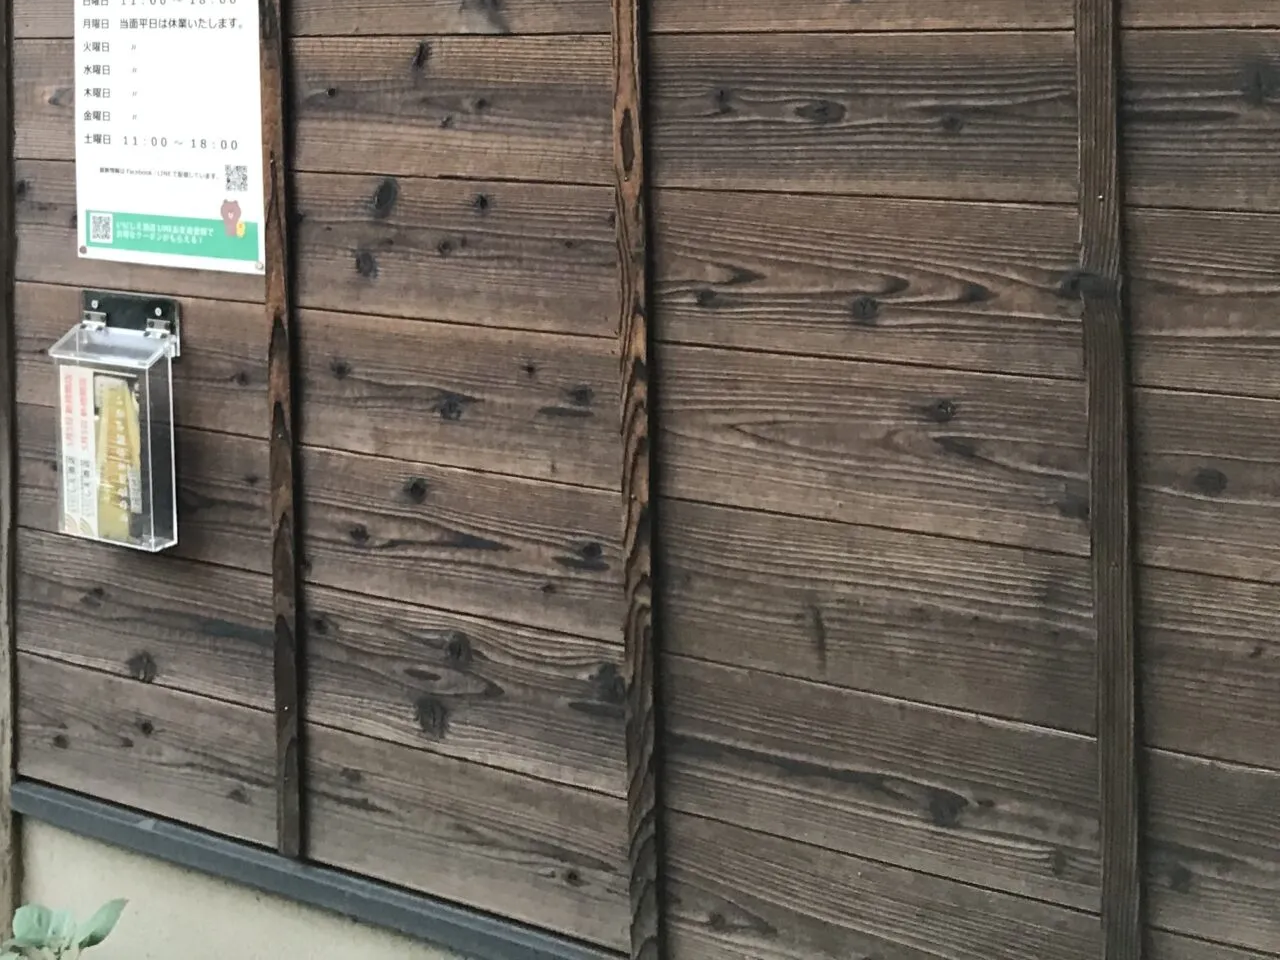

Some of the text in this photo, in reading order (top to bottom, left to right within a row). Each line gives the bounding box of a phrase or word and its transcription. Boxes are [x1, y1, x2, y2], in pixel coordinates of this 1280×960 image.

[82, 17, 243, 30] 月曜日 当面平日は休業いたします。
[83, 41, 110, 53] 火曜日
[83, 64, 111, 76] 水曜日
[83, 87, 111, 98] 木曜日
[83, 110, 111, 122] 金曜日
[83, 133, 111, 145] 土曜日
